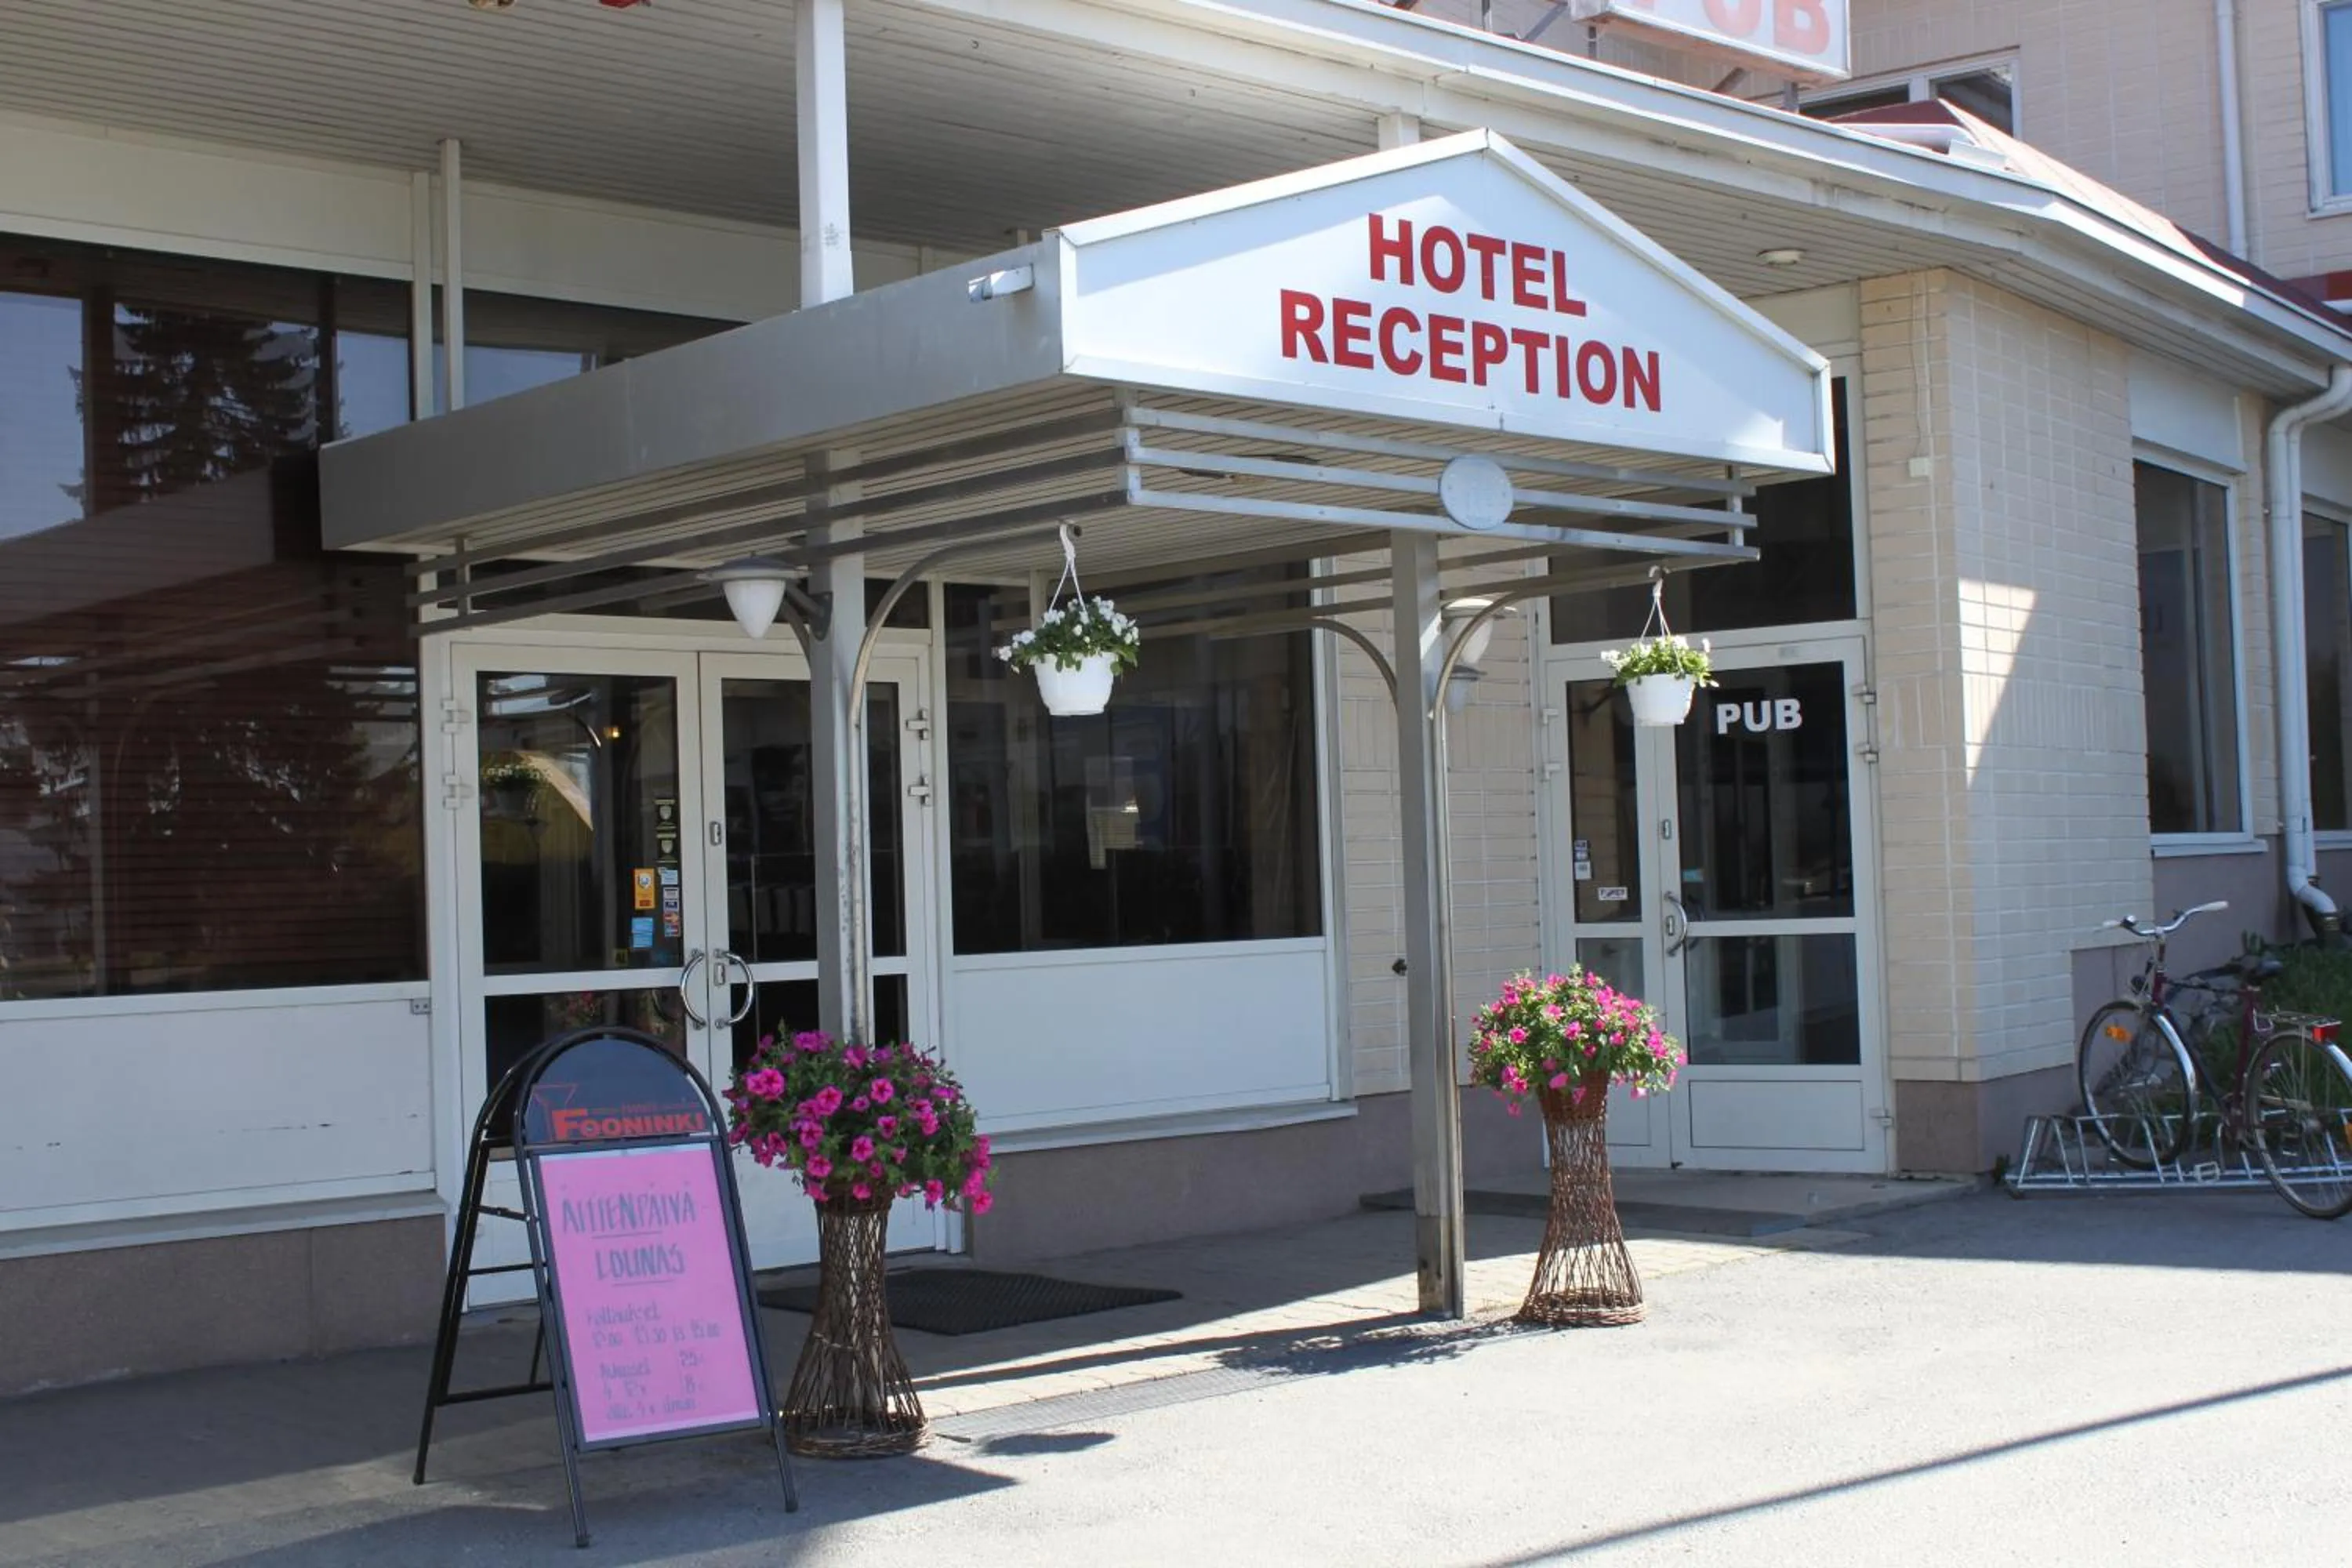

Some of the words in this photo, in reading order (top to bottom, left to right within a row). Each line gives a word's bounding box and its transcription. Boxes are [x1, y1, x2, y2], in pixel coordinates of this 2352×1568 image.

[1368, 212, 1587, 317] HOTEL
[1279, 288, 1661, 412] RECEPTION
[1715, 698, 1803, 735] PUB
